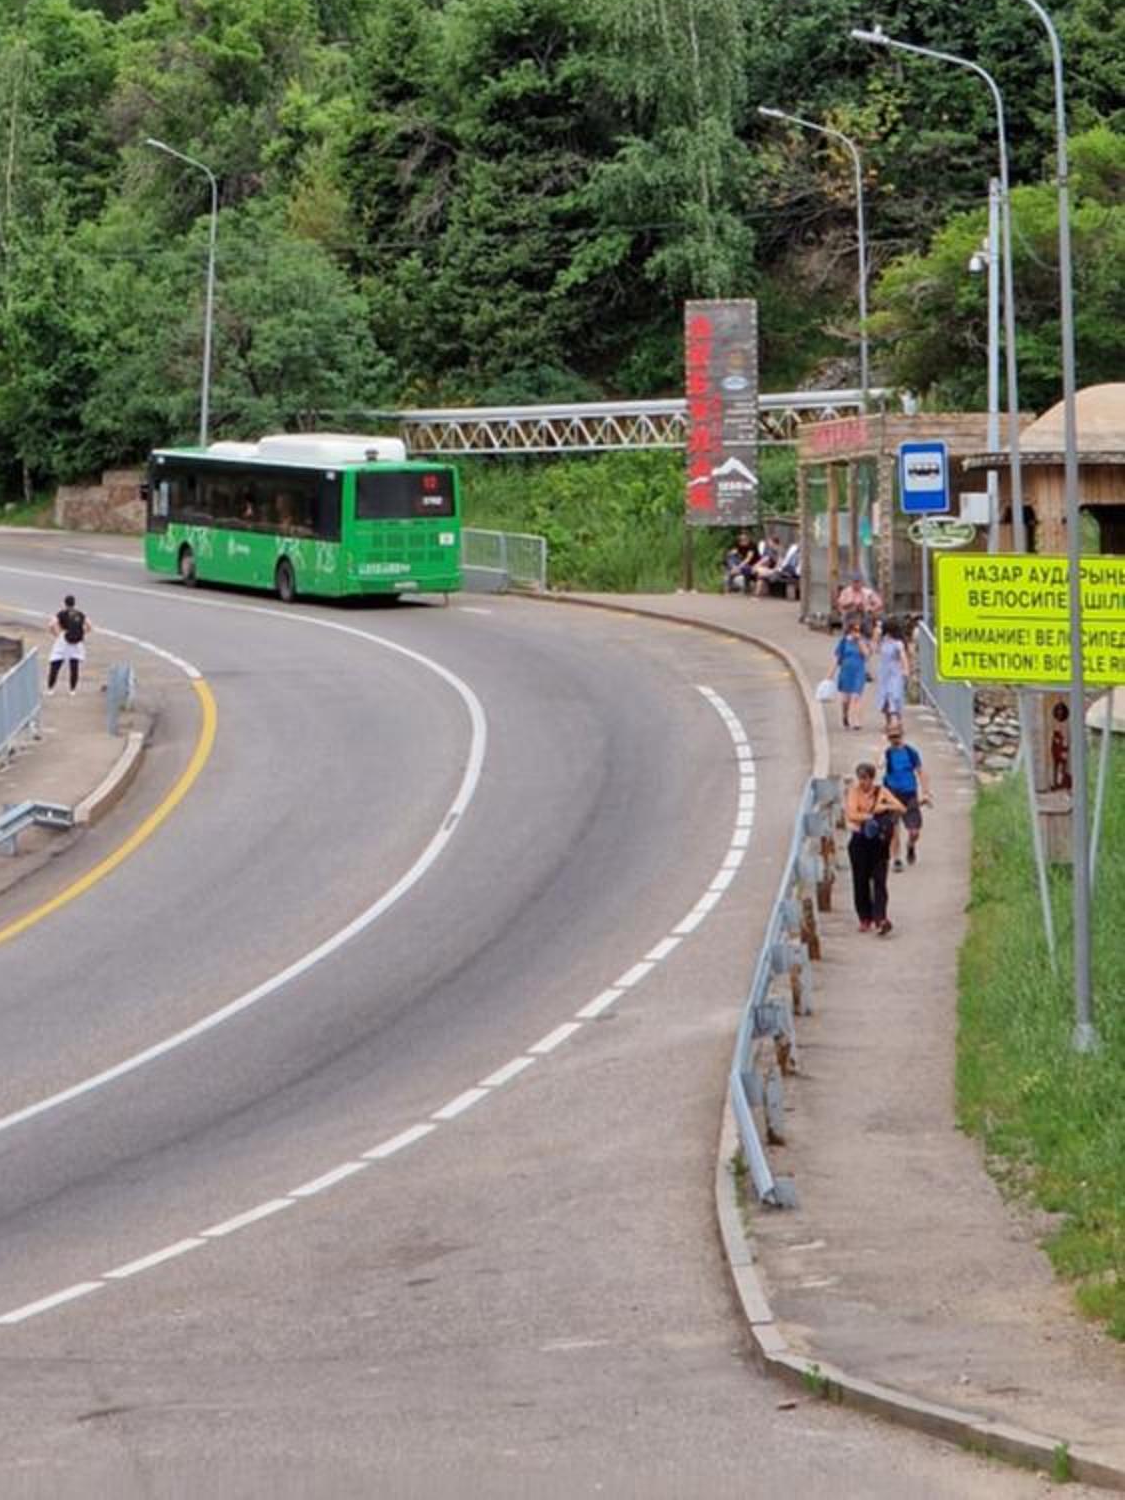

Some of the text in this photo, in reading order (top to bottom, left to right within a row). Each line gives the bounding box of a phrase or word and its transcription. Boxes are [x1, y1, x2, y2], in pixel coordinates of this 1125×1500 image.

[964, 565, 1023, 583] НАЗАР
[968, 590, 1125, 612] ВЕЛОСИПЕШІЛ
[943, 626, 1030, 646] ВНИМАНИЕ!
[952, 652, 1038, 671] ATTENTION!
[1043, 655, 1105, 673] BICLE
